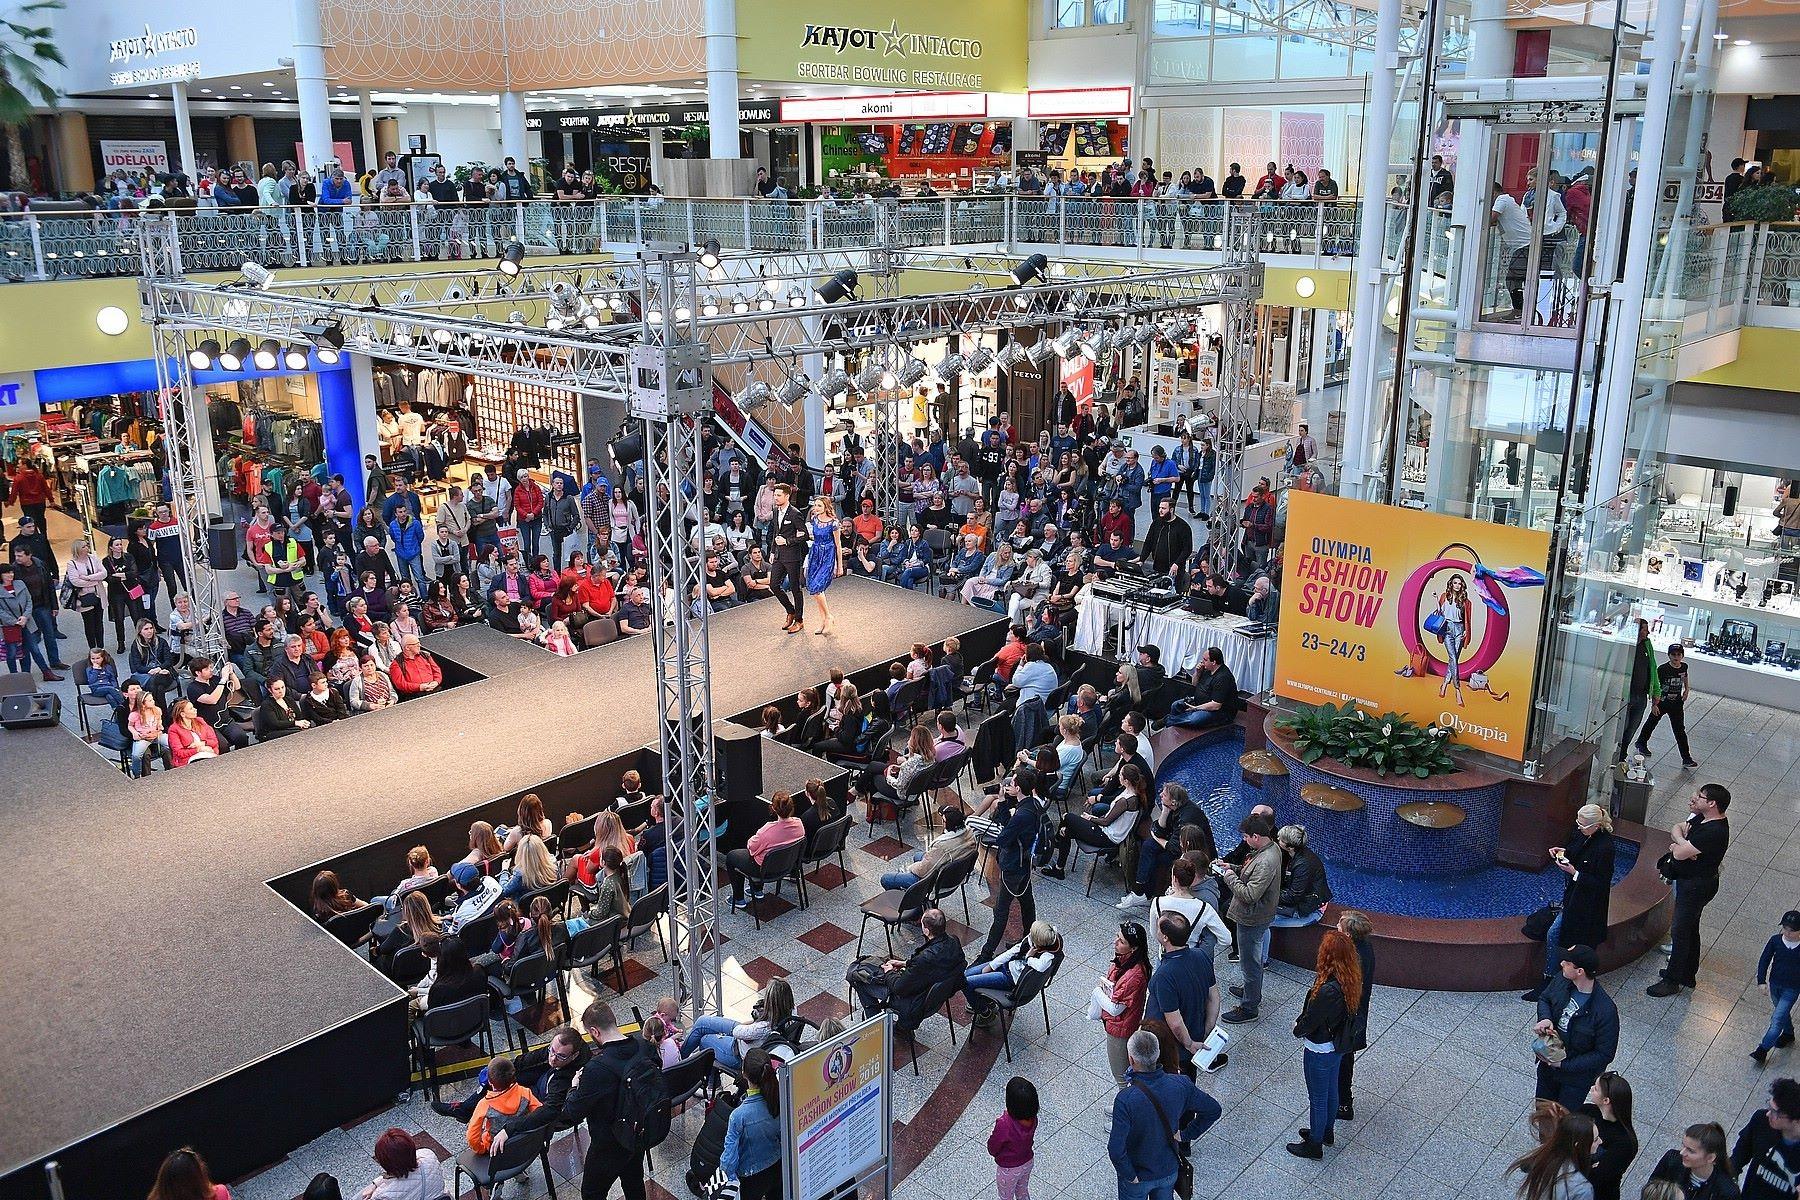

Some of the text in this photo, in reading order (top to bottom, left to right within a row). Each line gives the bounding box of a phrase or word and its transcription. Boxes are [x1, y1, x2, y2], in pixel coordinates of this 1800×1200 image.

[800, 24, 983, 59] KAJOT INTACTO
[798, 62, 983, 89] SPORTBAR BOWLING RESTAURACE
[559, 116, 590, 127] SPORTBAR
[636, 112, 671, 124] INTACTO
[738, 108, 771, 120] BOWLING
[861, 102, 893, 114] akomi
[105, 153, 165, 166] UDĚLALI?
[822, 144, 858, 156] Chinese
[1013, 370, 1042, 380] TEZYO
[1312, 537, 1371, 564] OLYMPIA
[1297, 554, 1388, 594] FASHION
[1299, 582, 1383, 629] SHOW
[1440, 711, 1508, 743] Olympia
[859, 1061, 880, 1085] 2019
[797, 1095, 820, 1117] OLYMPIA
[798, 1078, 857, 1131] FASHION SHOW
